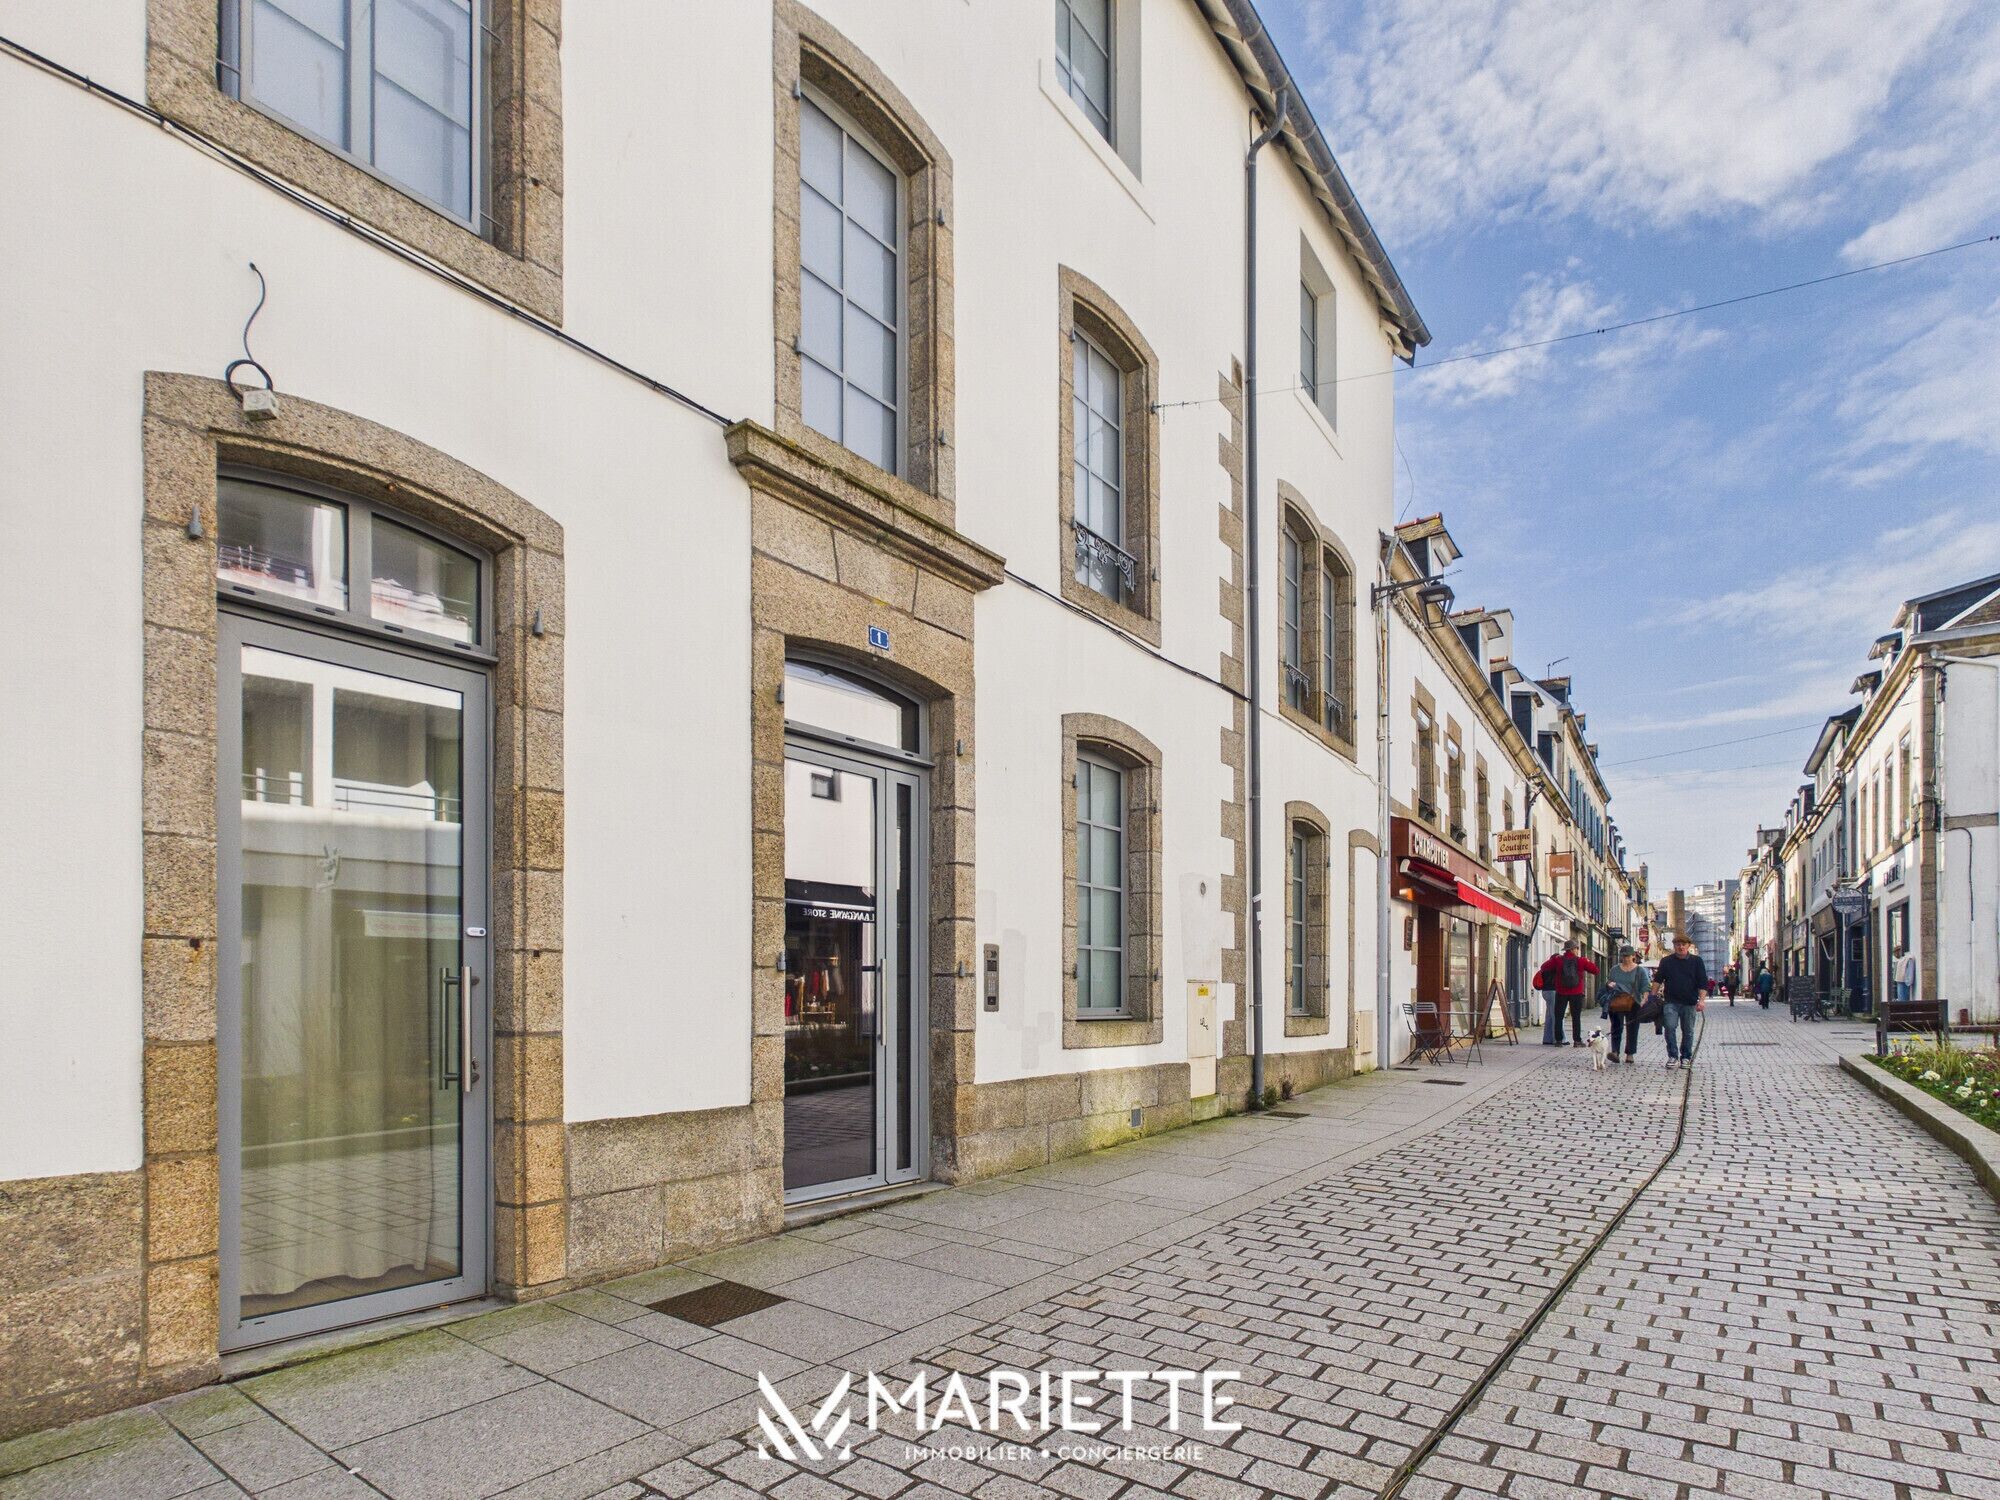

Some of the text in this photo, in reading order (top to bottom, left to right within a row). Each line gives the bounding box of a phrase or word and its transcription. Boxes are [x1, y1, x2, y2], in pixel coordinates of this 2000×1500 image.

[876, 631, 882, 645] 1
[1497, 833, 1531, 843] Fabienne
[1499, 843, 1529, 853] Couture
